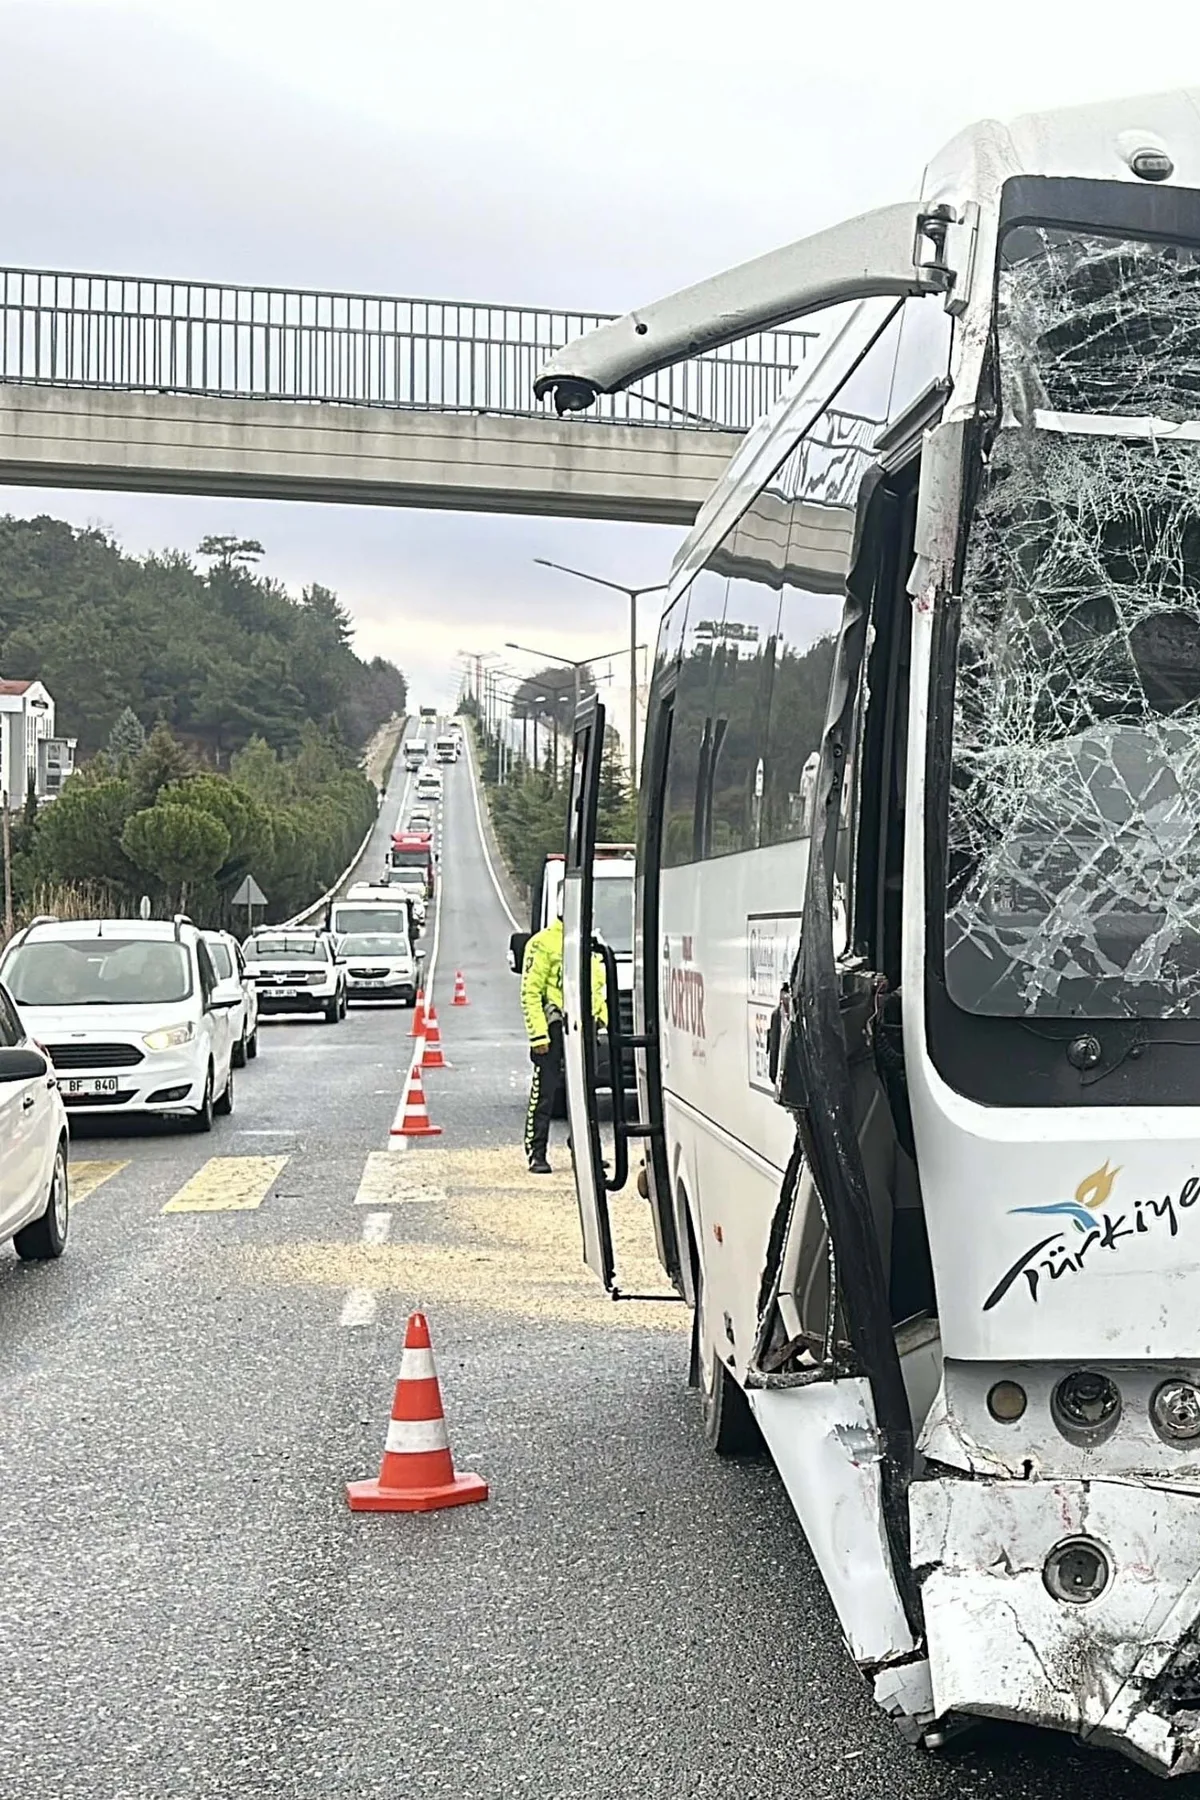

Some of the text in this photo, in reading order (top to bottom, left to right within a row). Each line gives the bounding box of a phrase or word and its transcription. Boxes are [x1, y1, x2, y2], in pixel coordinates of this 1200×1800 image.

[671, 967, 706, 1039] ORTUR
[69, 1080, 83, 1091] BF
[94, 1079, 115, 1091] 840
